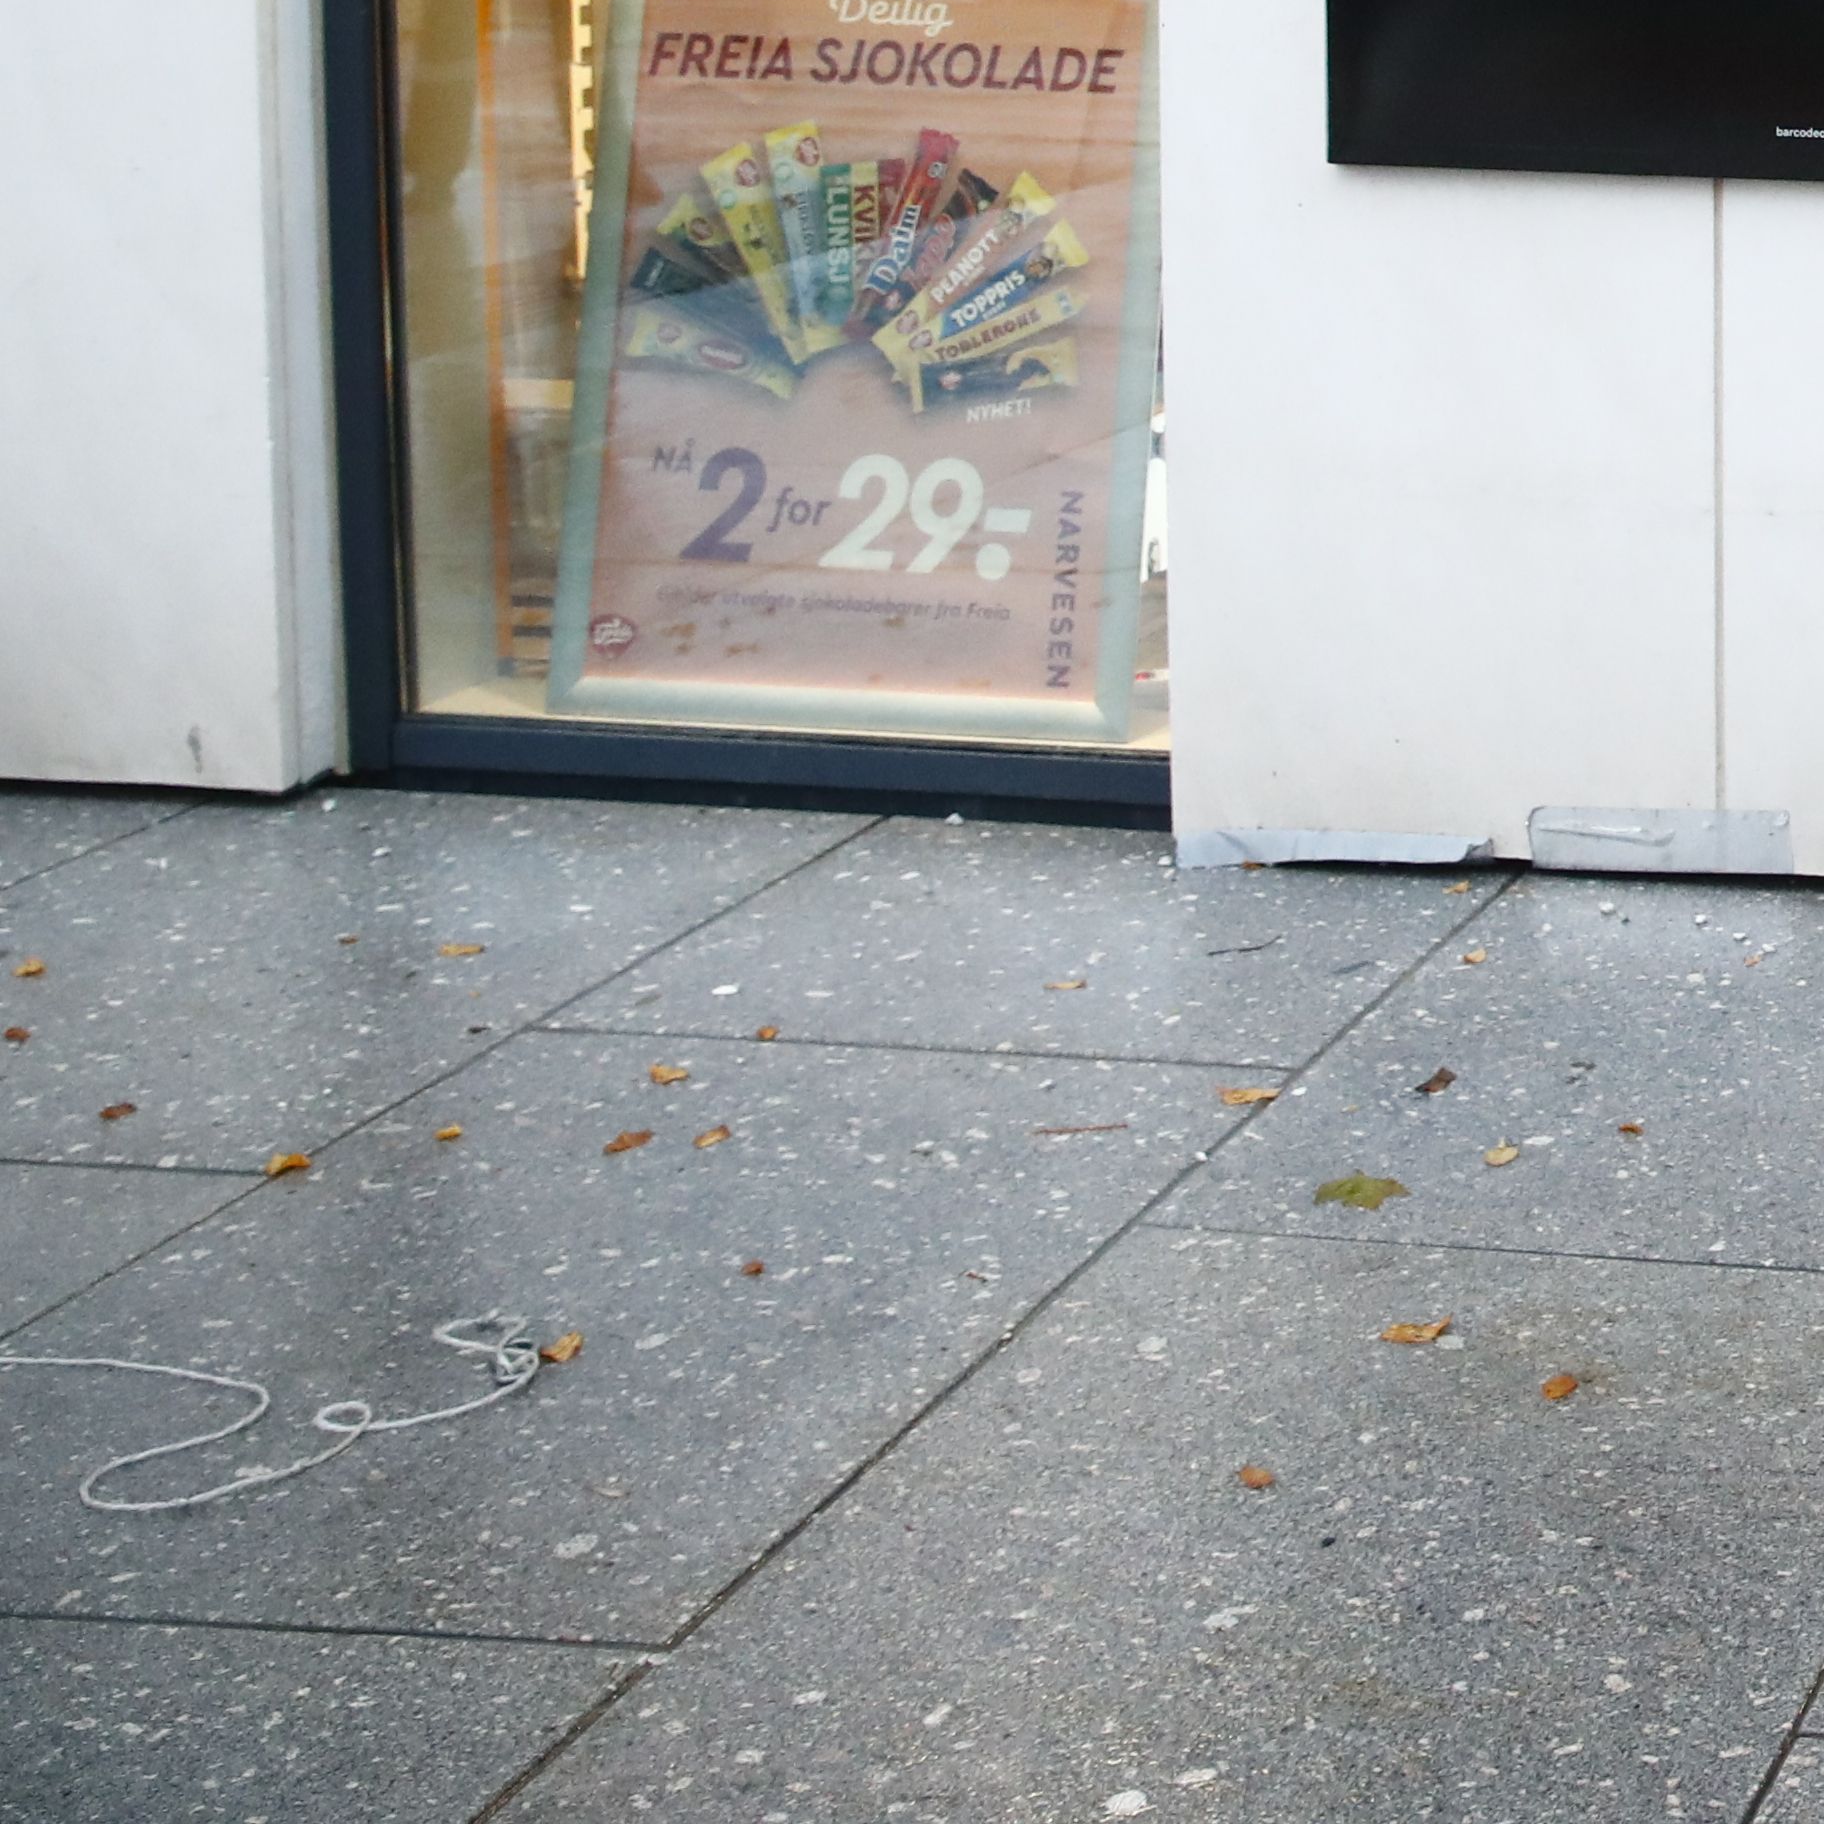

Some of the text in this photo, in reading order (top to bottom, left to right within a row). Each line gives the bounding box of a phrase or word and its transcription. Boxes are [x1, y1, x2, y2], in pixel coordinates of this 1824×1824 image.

[648, 32, 1124, 96] FREIA SJOKOLADE
[825, 185, 848, 284] LUNSJ
[863, 205, 921, 293] Daim
[936, 308, 1042, 361] TOBLERONE
[951, 270, 1027, 328] TOPPRIS
[966, 399, 1032, 424] NYHET!
[651, 444, 695, 474] NÅ
[677, 446, 770, 565] 2
[768, 487, 831, 535] for
[1046, 489, 1083, 691] NARVESEN
